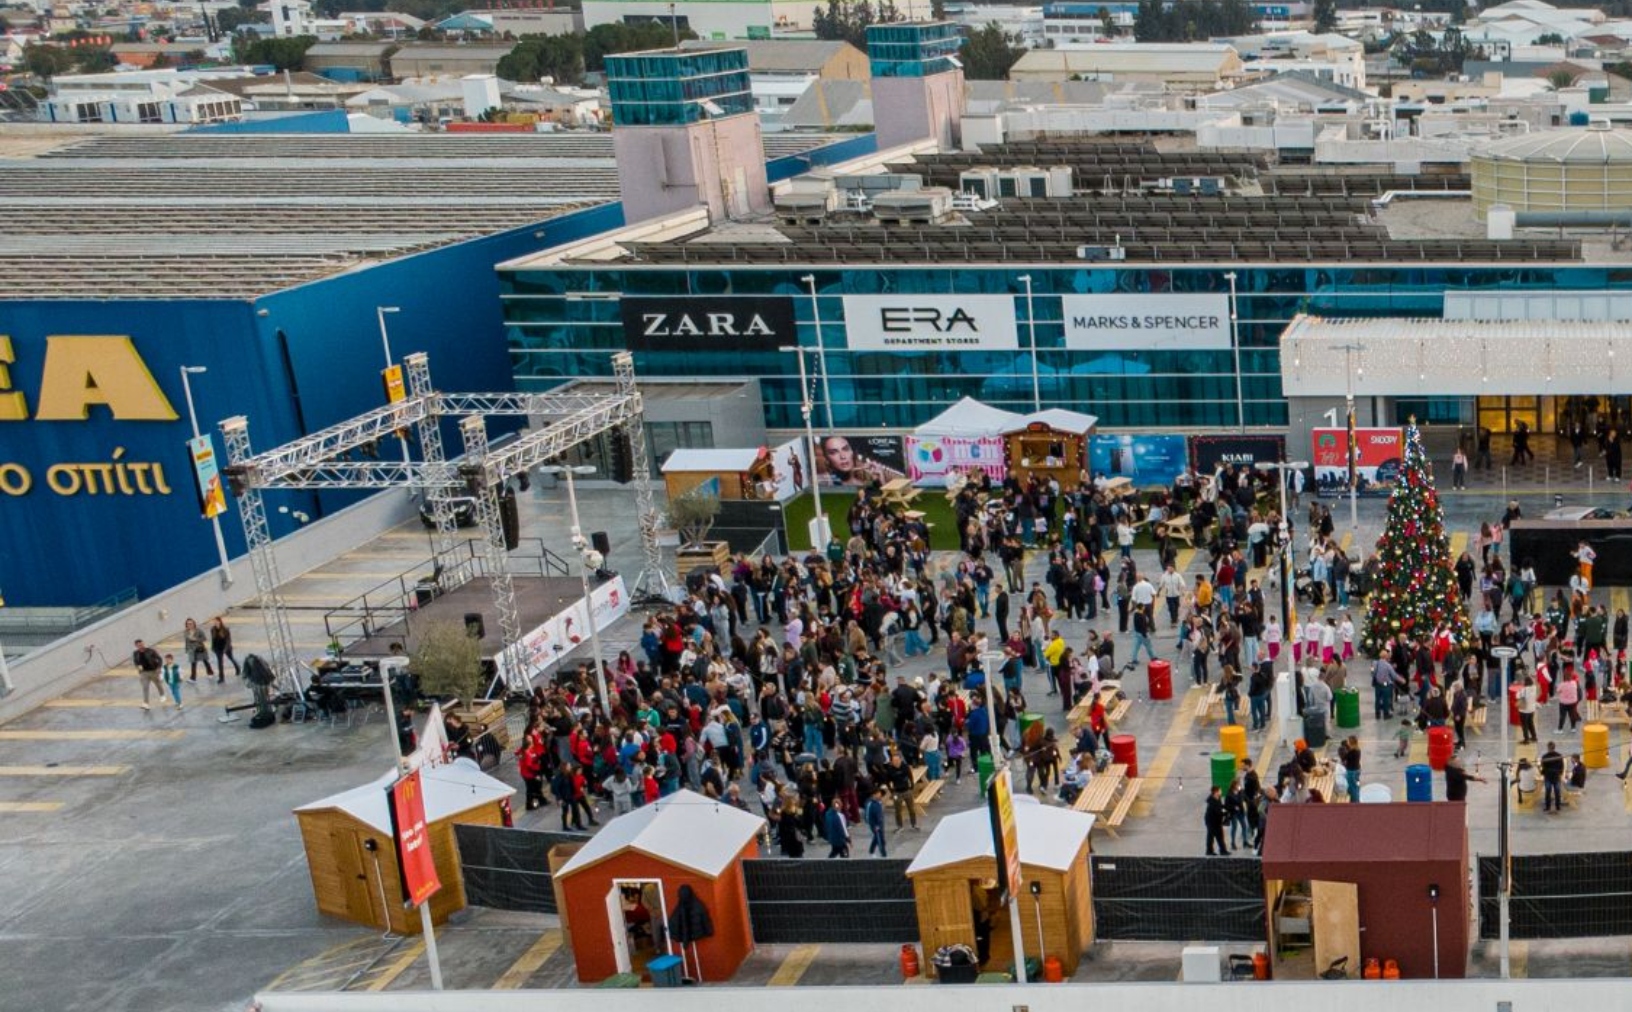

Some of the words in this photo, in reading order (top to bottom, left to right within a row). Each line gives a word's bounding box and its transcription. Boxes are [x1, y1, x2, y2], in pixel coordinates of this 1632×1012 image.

[643, 313, 776, 336] ZARA
[880, 307, 978, 332] ERA
[1073, 316, 1128, 329] MARKS
[1130, 316, 1142, 329] &
[1144, 316, 1219, 329] SPENCER
[1370, 436, 1398, 444] SNOOPY
[1222, 453, 1253, 462] KIABI
[46, 446, 172, 496] σπίτι
